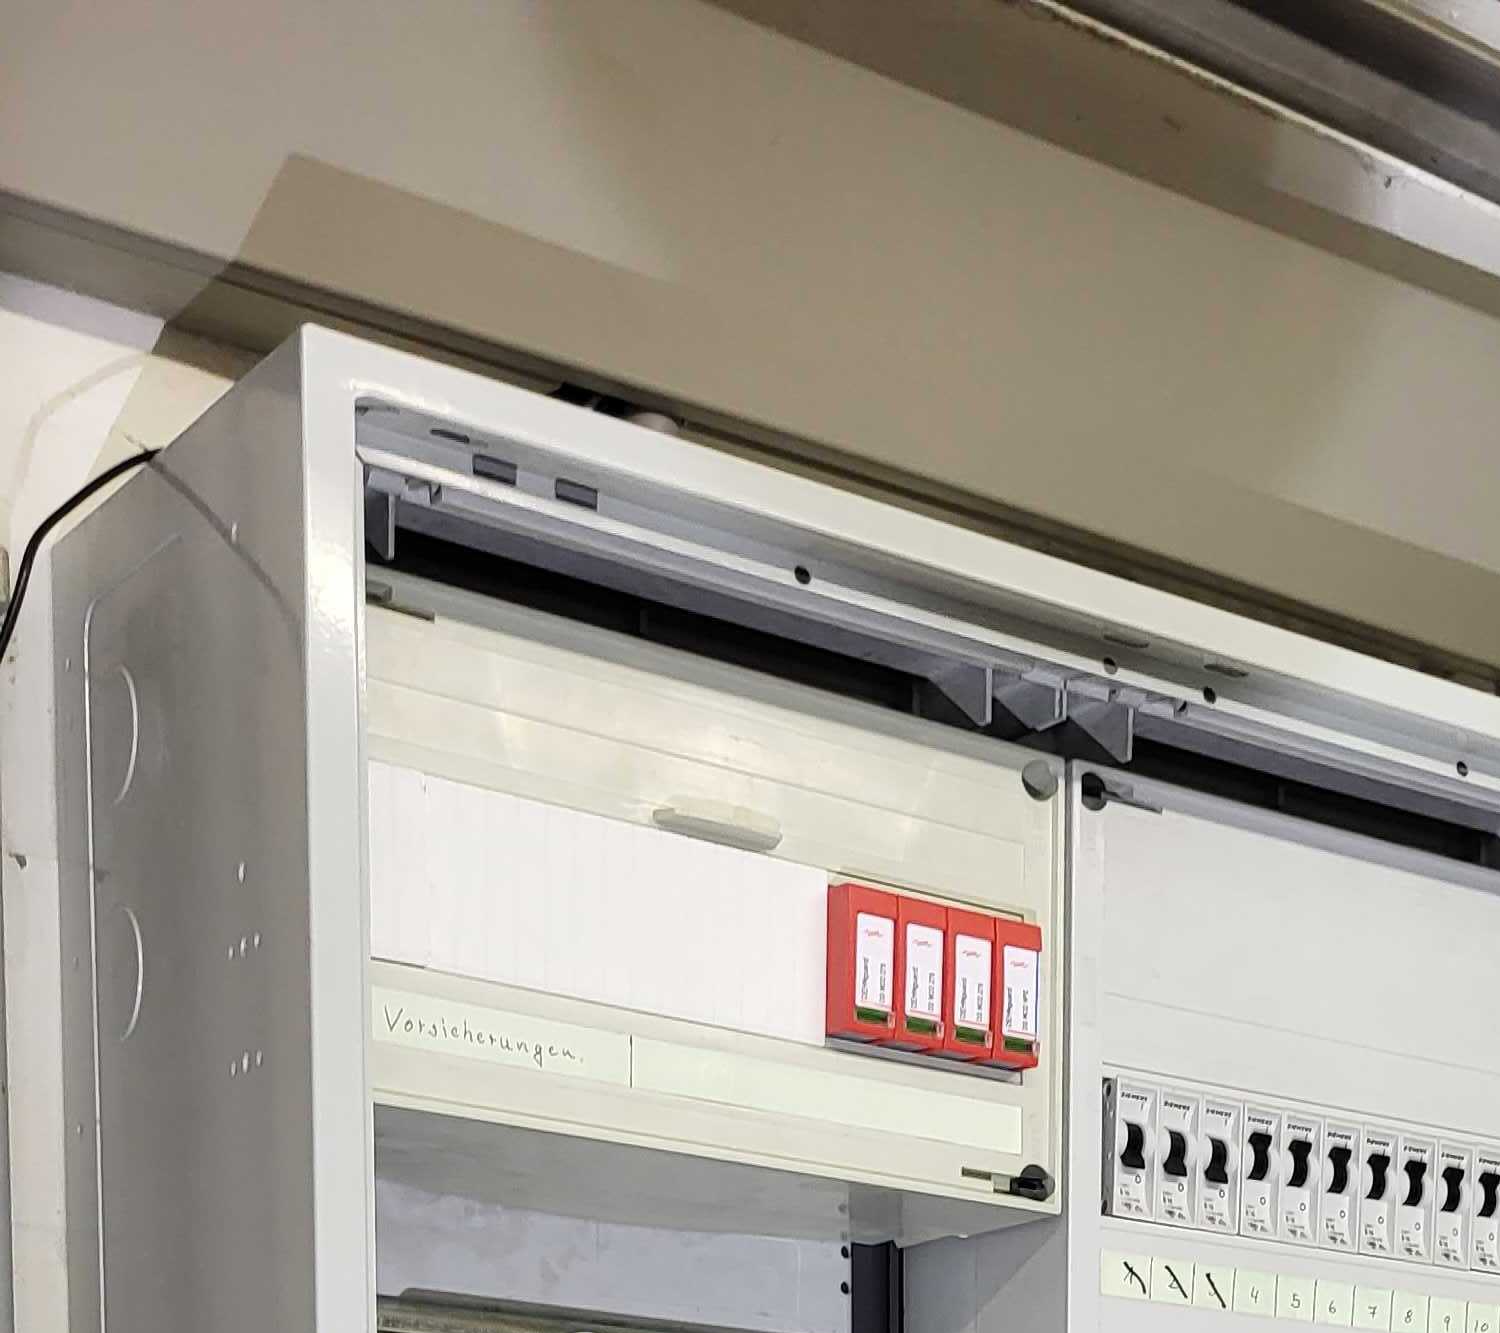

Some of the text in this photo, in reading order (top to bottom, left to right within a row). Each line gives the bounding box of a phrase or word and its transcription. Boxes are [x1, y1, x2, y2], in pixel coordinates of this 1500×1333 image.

[1250, 1286, 1259, 1304] 4
[1290, 1293, 1301, 1308] 5
[1328, 1300, 1337, 1314] 6
[1368, 1304, 1377, 1319] 7
[1404, 1309, 1413, 1323] 8
[1443, 1315, 1451, 1332] 9
[1474, 1319, 1489, 1333] 10
